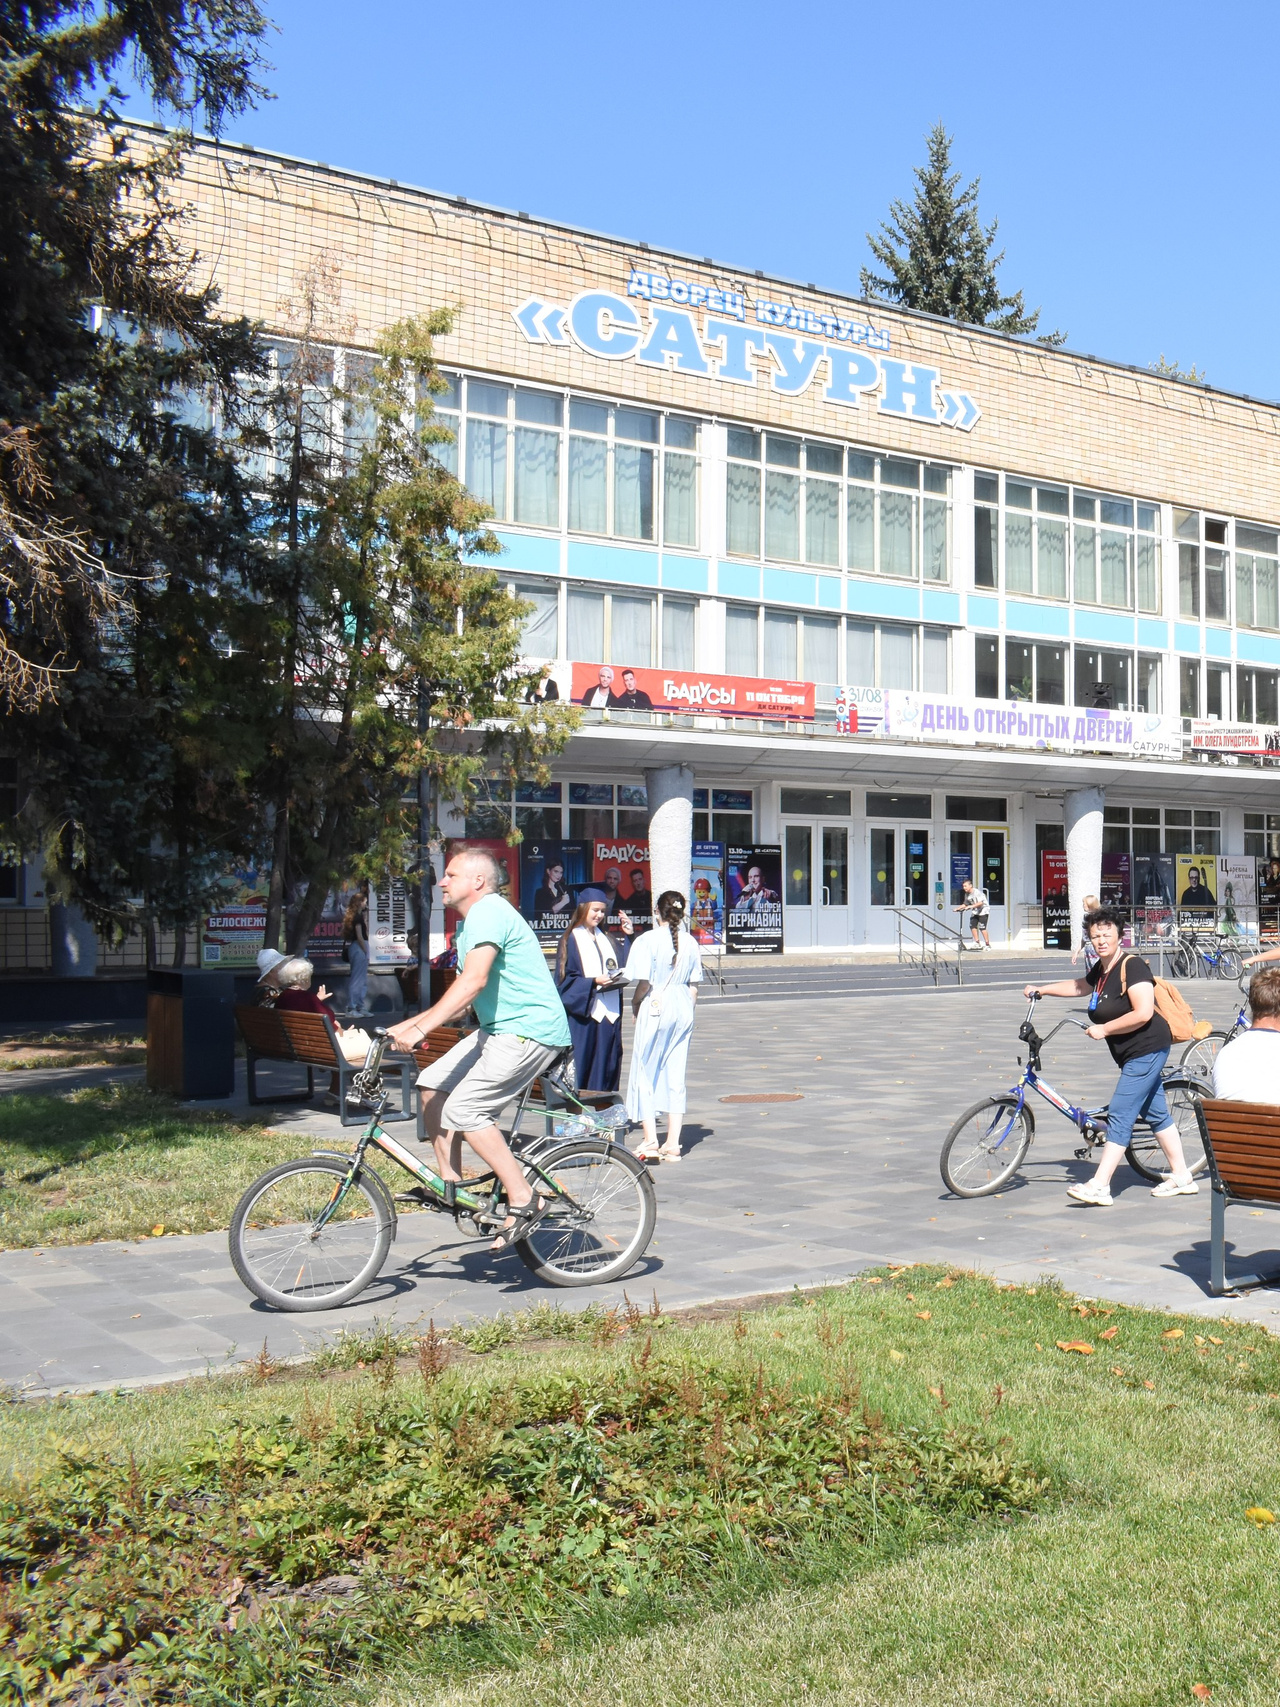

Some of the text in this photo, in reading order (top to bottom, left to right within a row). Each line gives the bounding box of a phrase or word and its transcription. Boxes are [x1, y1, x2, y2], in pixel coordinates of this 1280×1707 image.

[627, 269, 891, 352] ДВОРЕЦ КУЛЬТУРЫ
[510, 287, 984, 433] «САТУРН»
[663, 679, 736, 705] ГРАДУСЫ
[755, 692, 806, 706] ОКТЯБРЯ
[848, 687, 882, 703] 31/08
[768, 704, 794, 712] САТУРН
[920, 703, 1134, 745] ДЕНЬ ОТКРЫТЫХ ДВЕРЕЙ
[1132, 741, 1171, 753] САТУРН
[1204, 735, 1223, 747] ОЛЕГА
[1223, 735, 1260, 748] ЛУНДСТРЕМА
[532, 846, 539, 855] 9
[728, 847, 743, 855] 13.10
[392, 876, 406, 943] СУМИШЕВСК
[754, 901, 782, 913] АНДРЕЙ
[542, 912, 570, 922] Мария
[728, 912, 782, 928] ДЕРЖАВИН
